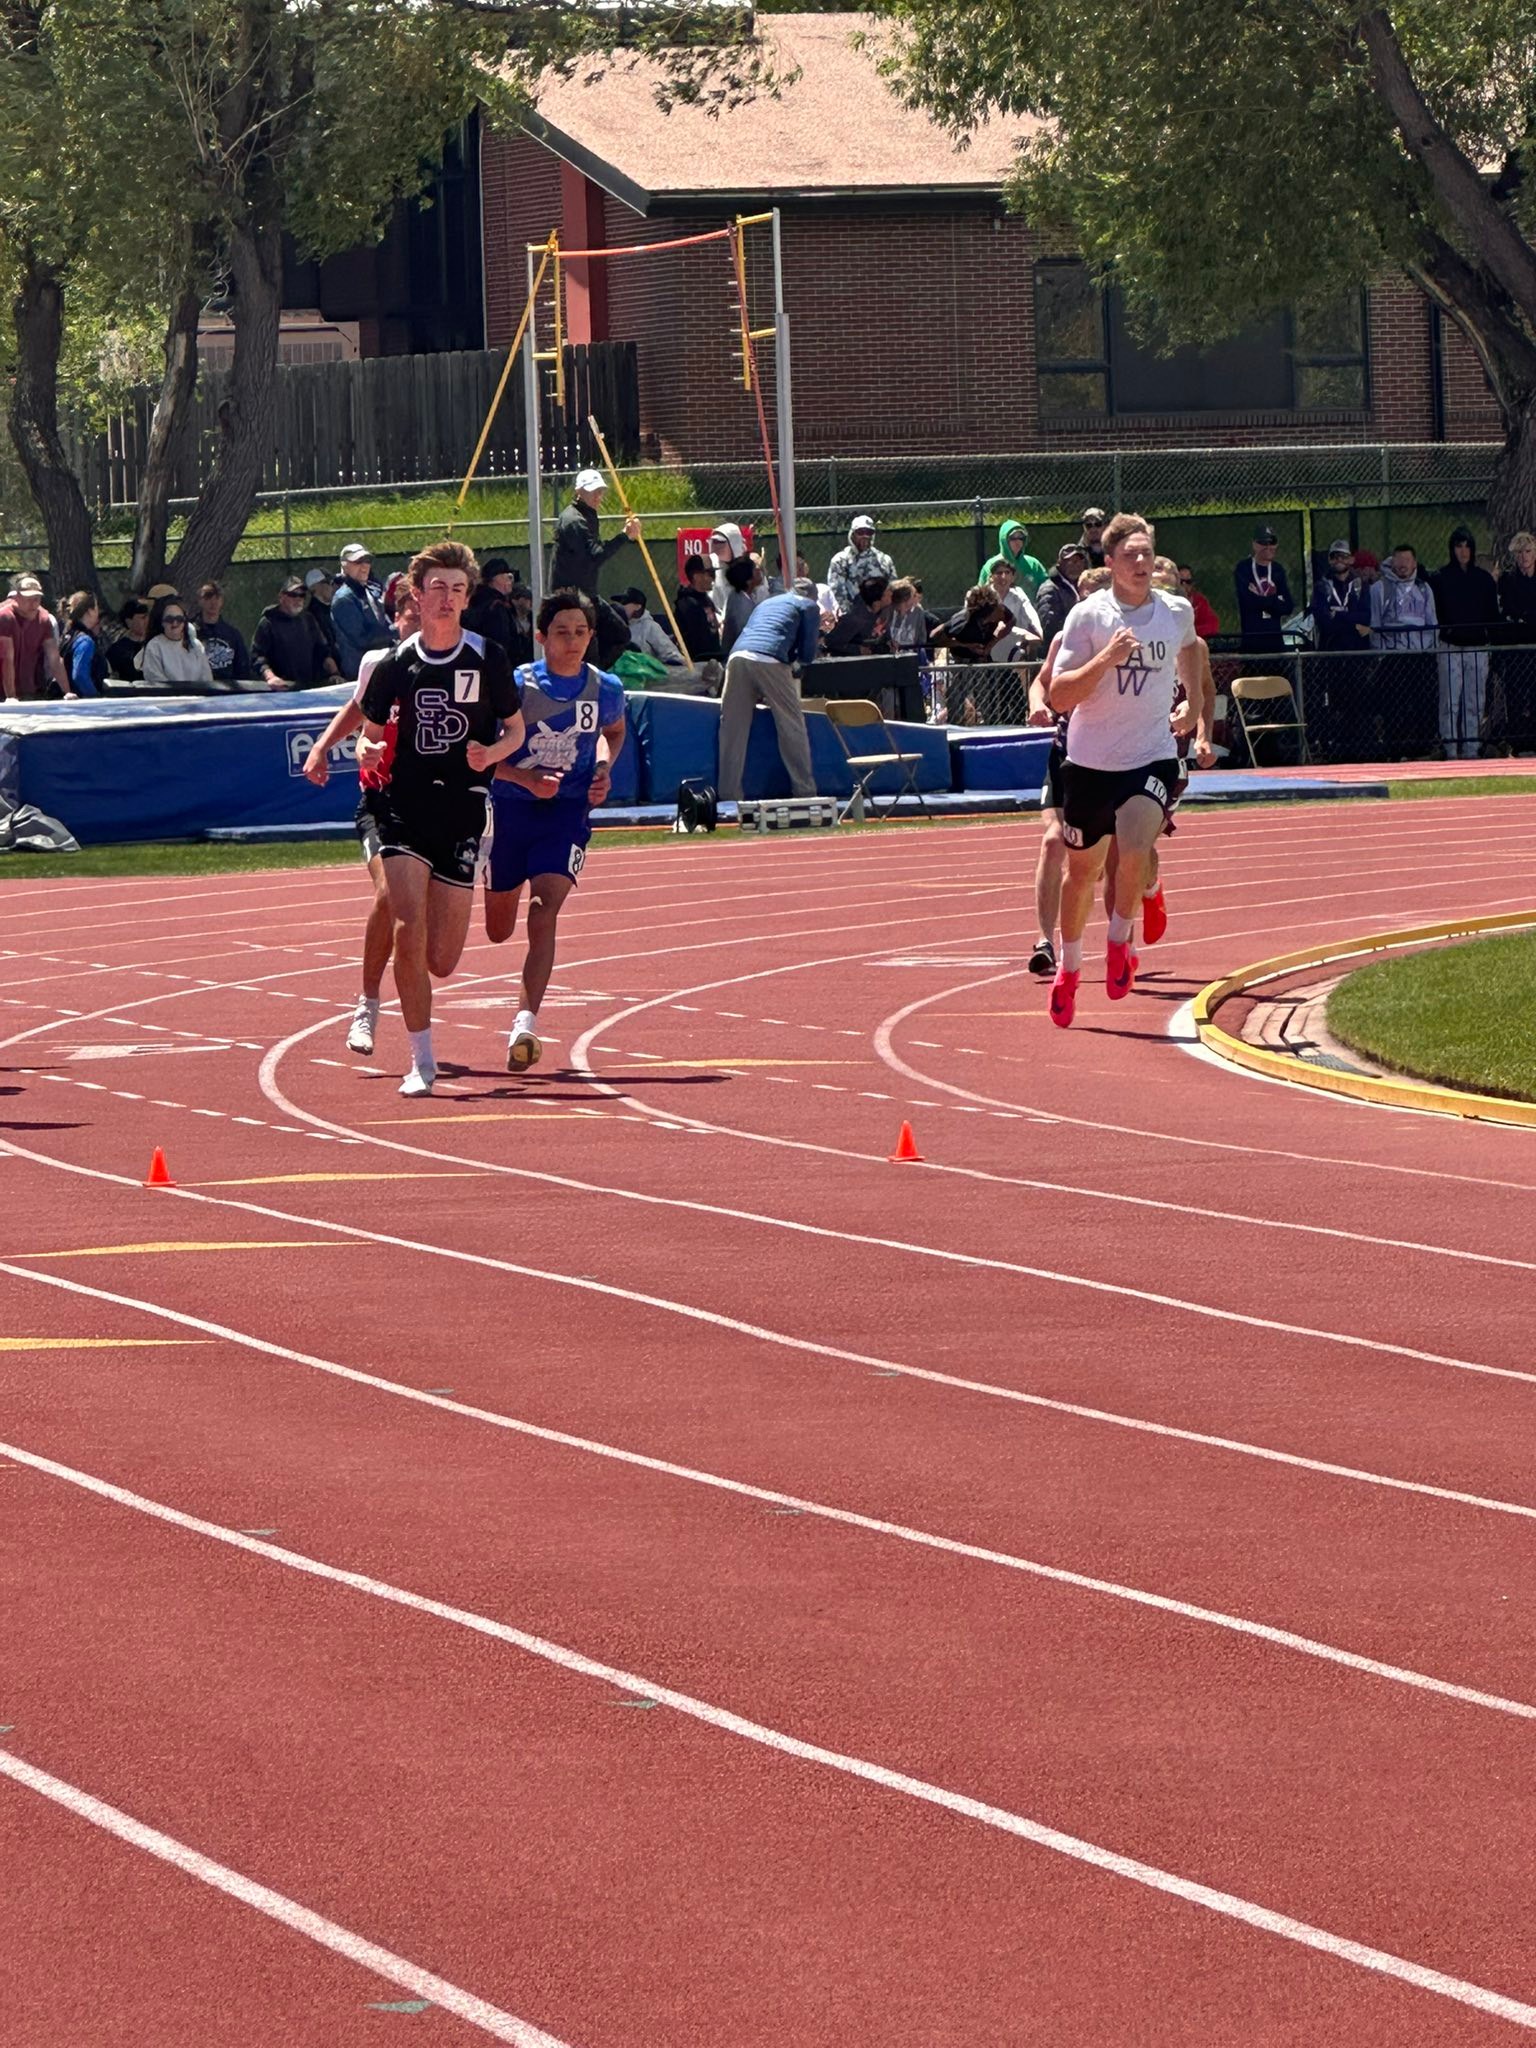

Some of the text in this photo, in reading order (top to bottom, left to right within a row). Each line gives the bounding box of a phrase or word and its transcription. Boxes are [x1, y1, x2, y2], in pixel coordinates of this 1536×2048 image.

[684, 539, 702, 555] NO
[1147, 640, 1166, 661] 10
[460, 672, 475, 701] 7
[1115, 665, 1152, 697] W
[580, 702, 594, 730] 8
[572, 848, 582, 875] 8
